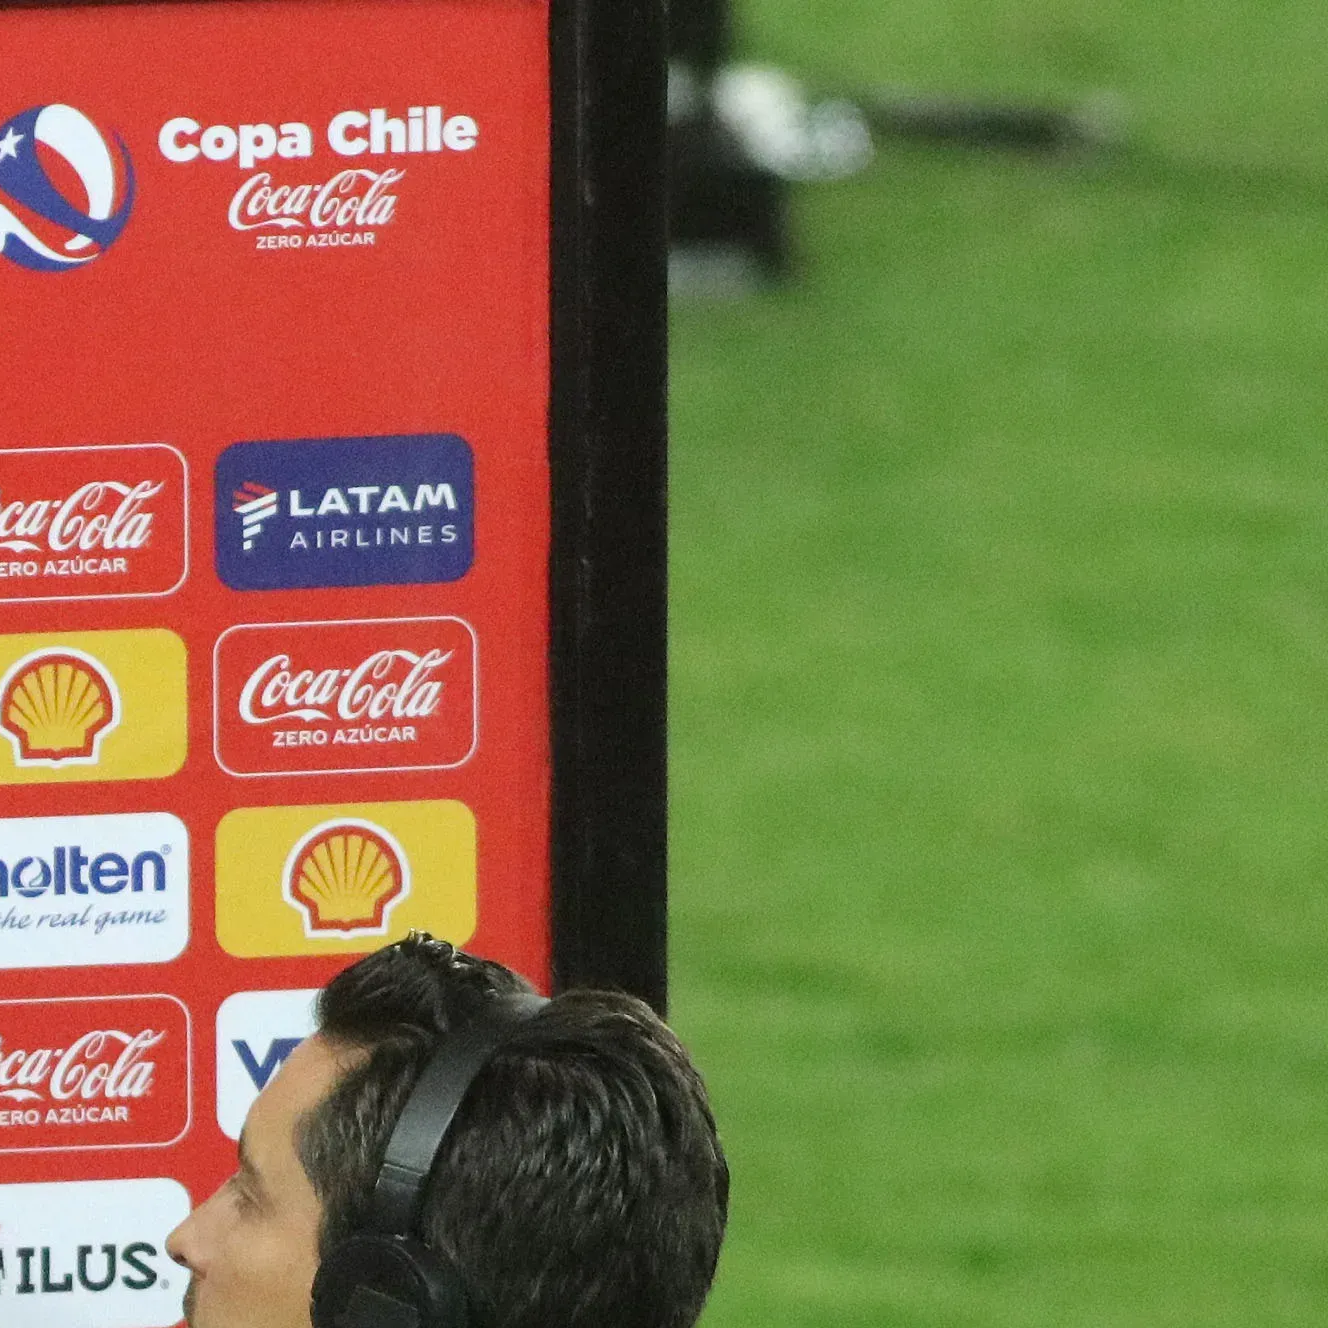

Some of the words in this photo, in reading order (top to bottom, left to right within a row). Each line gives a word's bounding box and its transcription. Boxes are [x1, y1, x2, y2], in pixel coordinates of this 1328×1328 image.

[158, 117, 312, 169] Copa
[328, 106, 478, 156] Chile
[228, 168, 405, 231] Coca-Cola
[256, 235, 303, 249] ZERO
[306, 231, 375, 247] AZÚCAR
[290, 484, 456, 516] LATAM
[290, 525, 457, 549] AIRLINES
[43, 556, 127, 575] AZÚCAR
[238, 649, 452, 725] Coca-Cola
[273, 730, 328, 747] ZERO
[333, 724, 416, 744] AZÚCAR
[36, 904, 94, 928] real
[94, 908, 167, 934] game
[45, 1104, 128, 1124] AZÚCAR
[17, 1242, 157, 1294] ILUS
